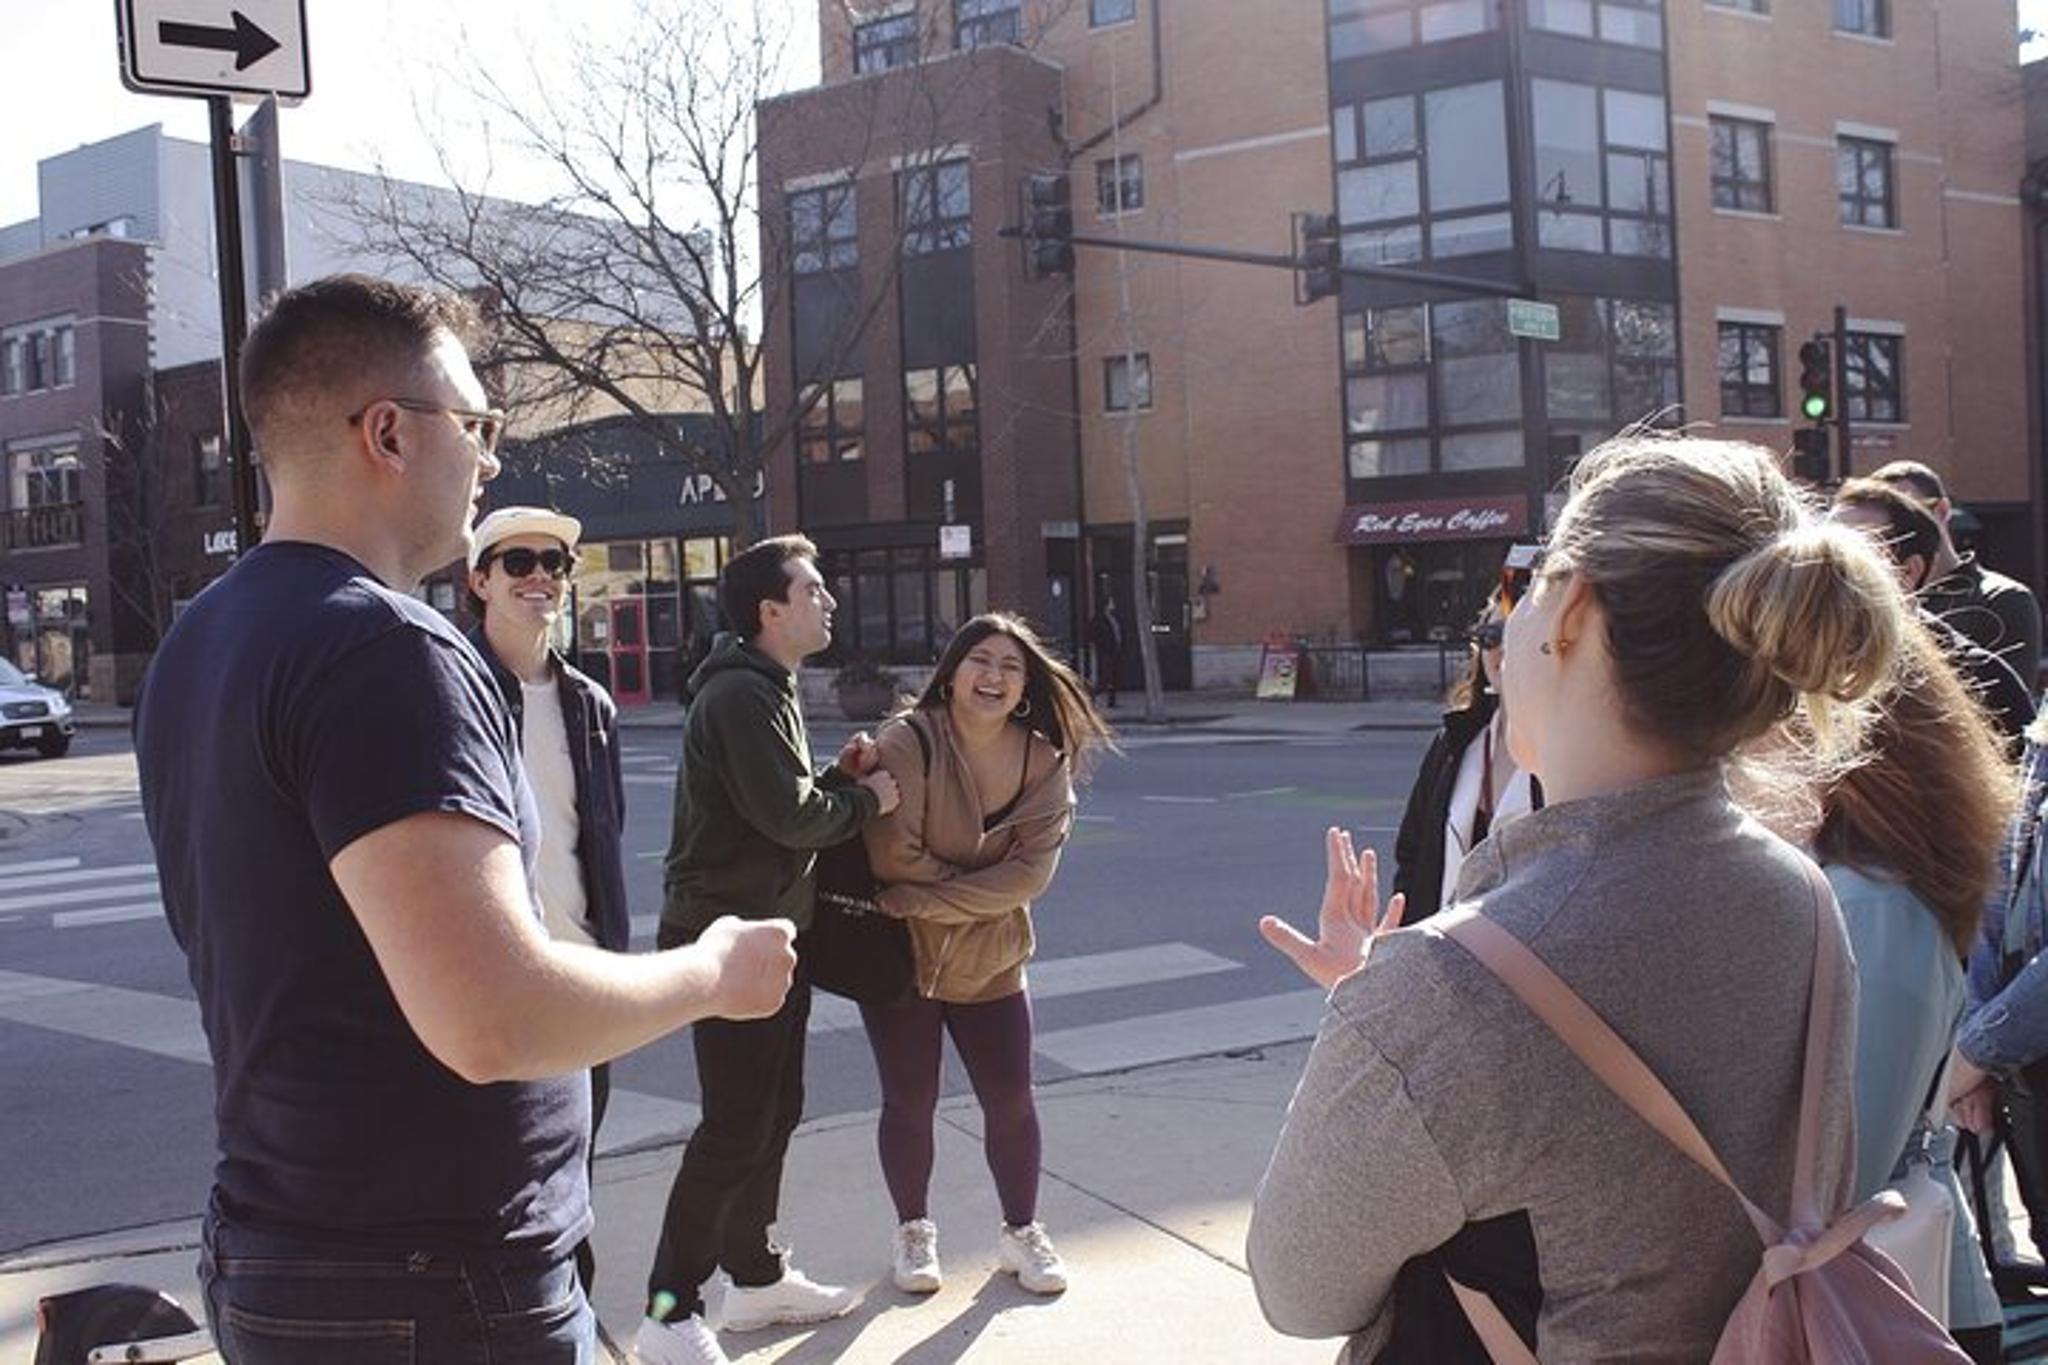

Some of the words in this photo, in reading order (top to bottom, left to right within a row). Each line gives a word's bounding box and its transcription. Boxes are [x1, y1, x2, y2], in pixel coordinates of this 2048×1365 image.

[1353, 513, 1398, 533] Red
[1397, 511, 1443, 533] Eyes
[1447, 508, 1510, 531] Coffee
